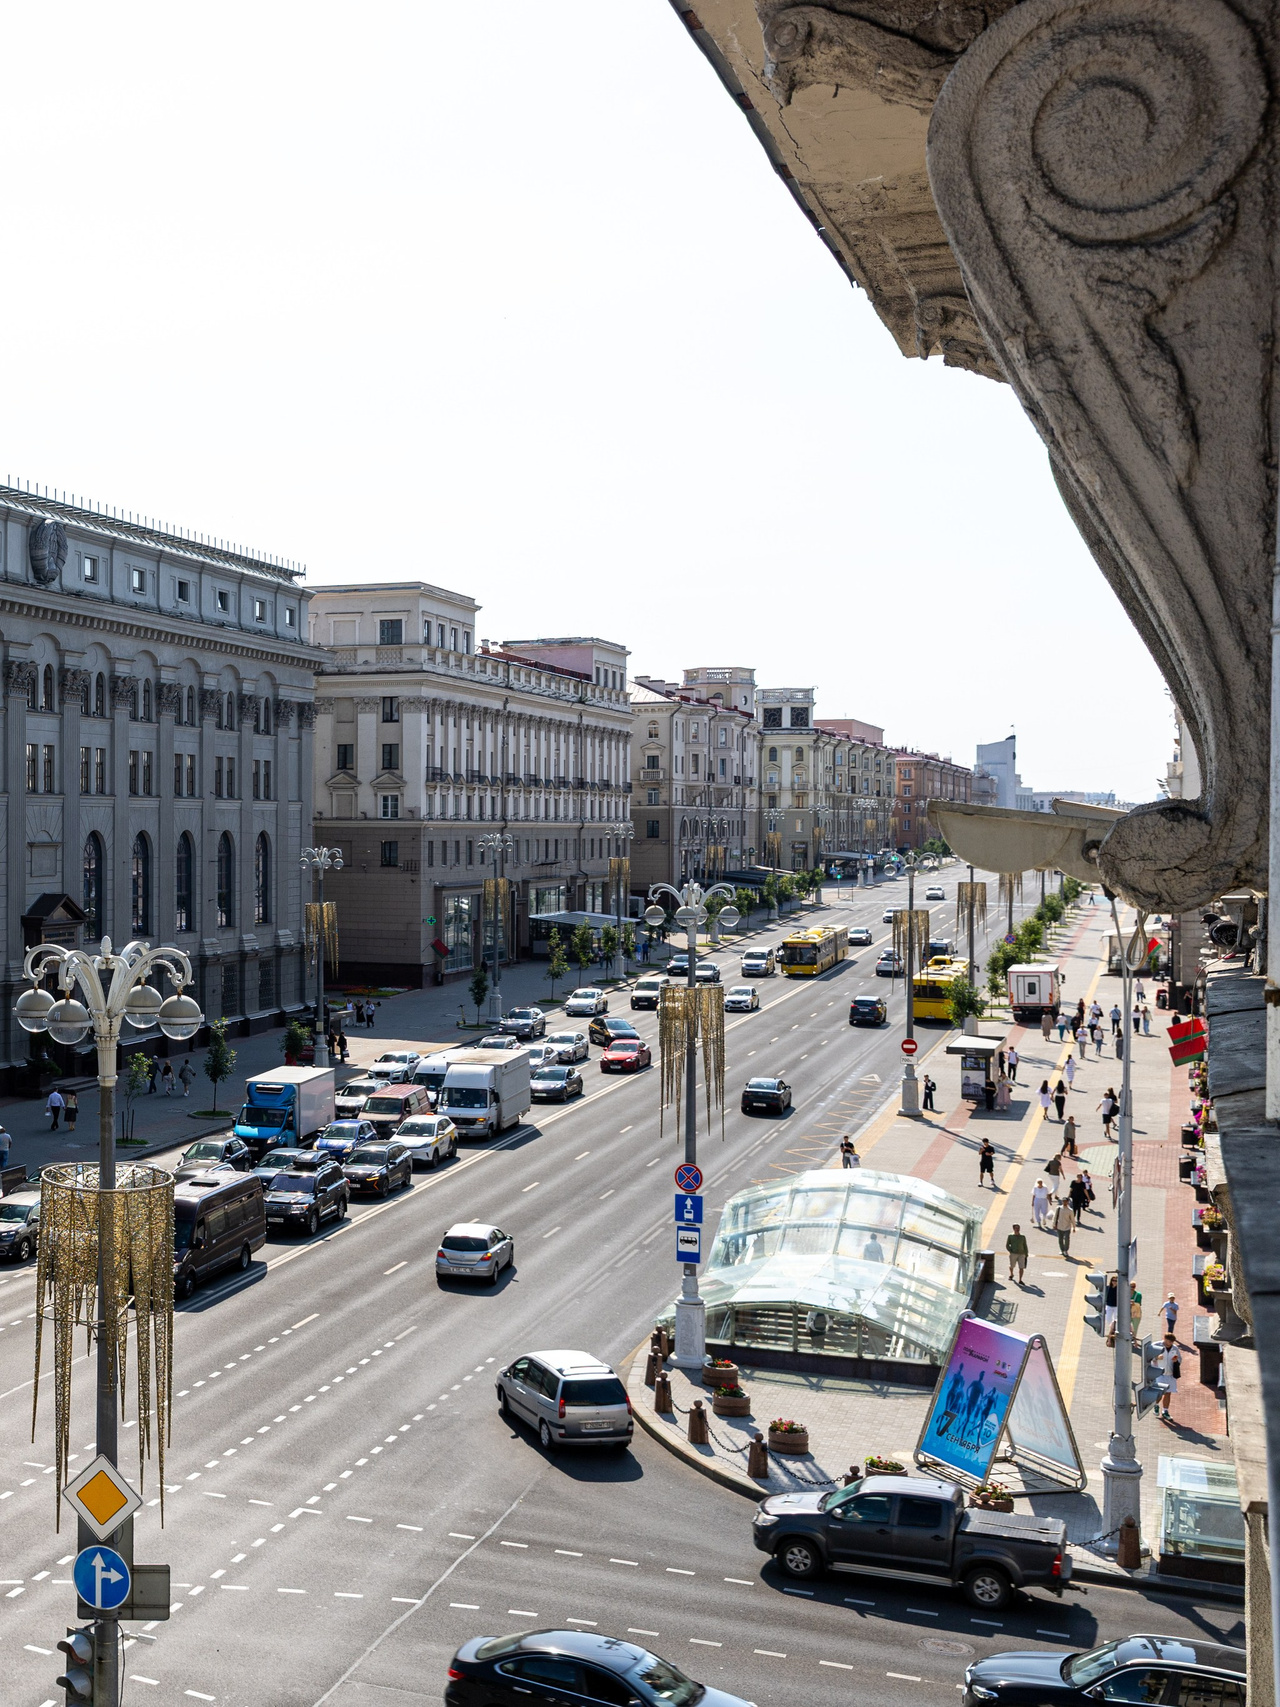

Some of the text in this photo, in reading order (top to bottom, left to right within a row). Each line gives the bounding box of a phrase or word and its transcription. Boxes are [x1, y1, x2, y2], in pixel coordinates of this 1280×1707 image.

[936, 1410, 980, 1453] 7 СЕНТЯБРЯ
[983, 1428, 992, 1438] 10
